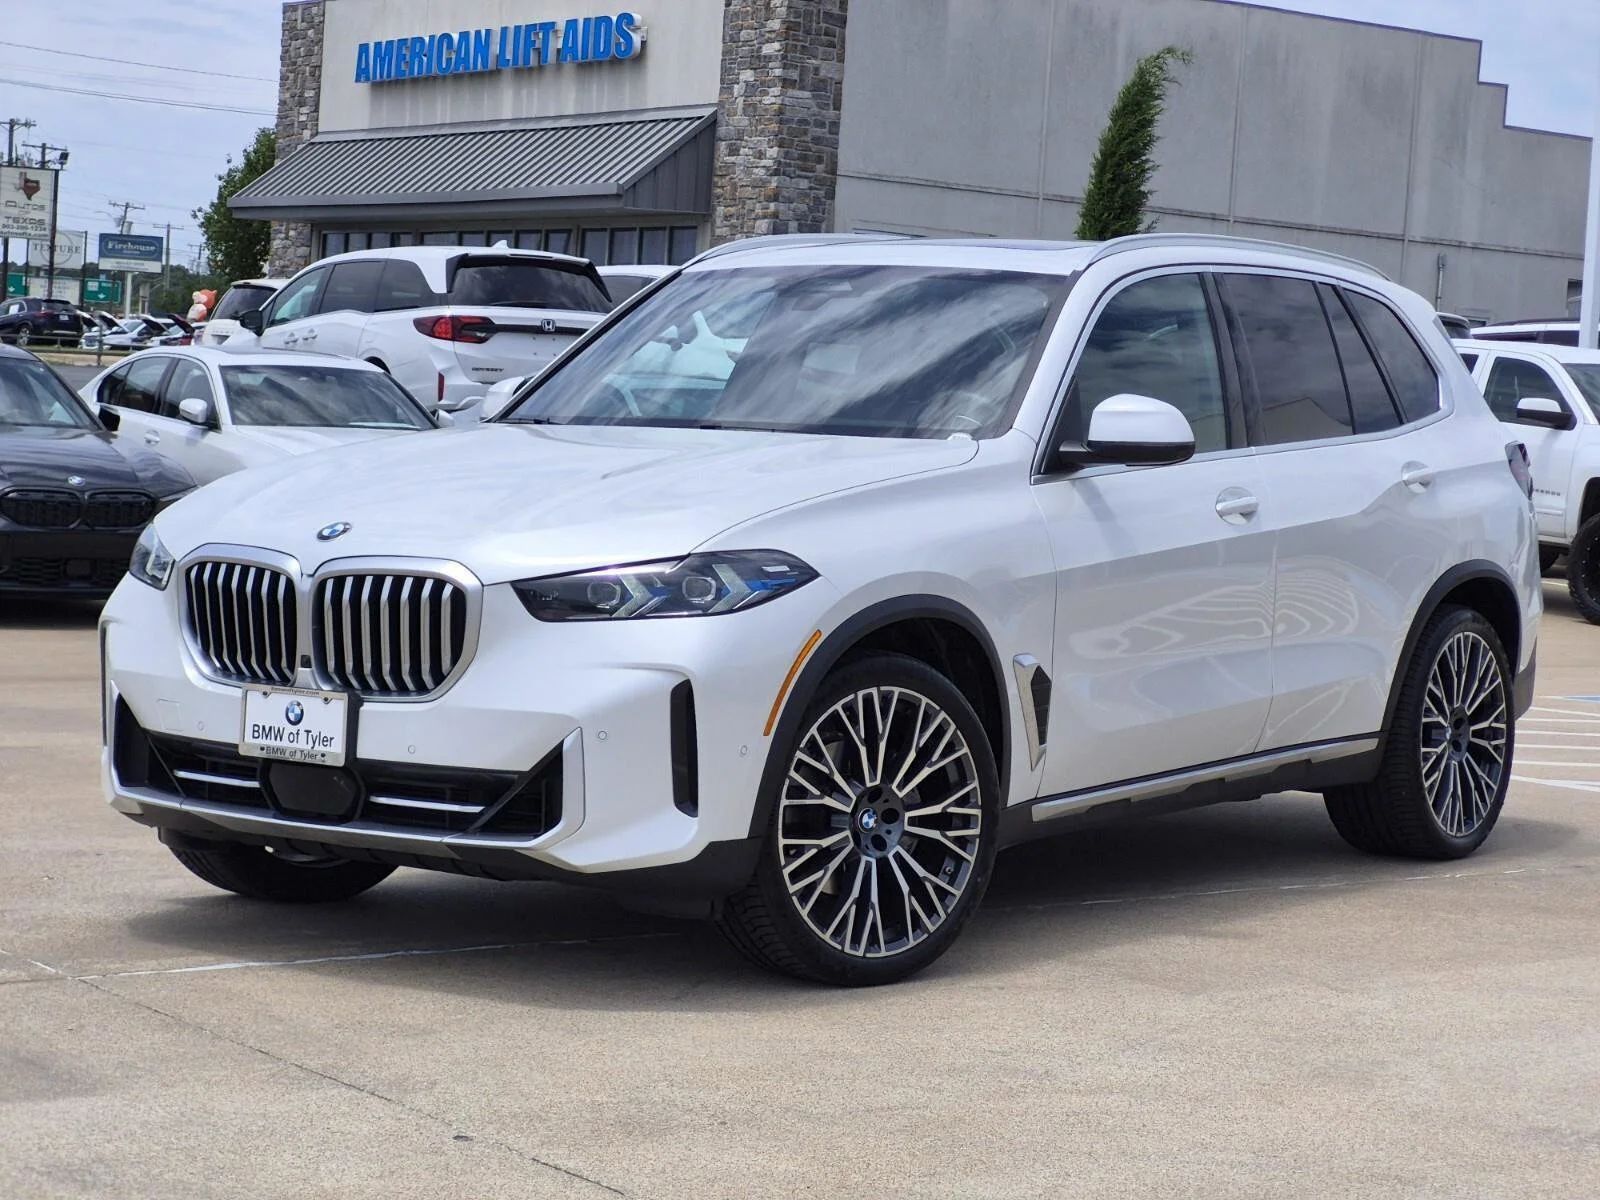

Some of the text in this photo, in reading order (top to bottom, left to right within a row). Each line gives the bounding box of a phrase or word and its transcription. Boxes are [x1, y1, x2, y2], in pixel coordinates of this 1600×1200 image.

[355, 11, 640, 83] AMERICAN LIFT AIDS
[108, 240, 157, 251] Firehouse
[251, 724, 335, 749] BMW of Tyler
[265, 746, 287, 756] BMW
[299, 750, 318, 761] Tyler
